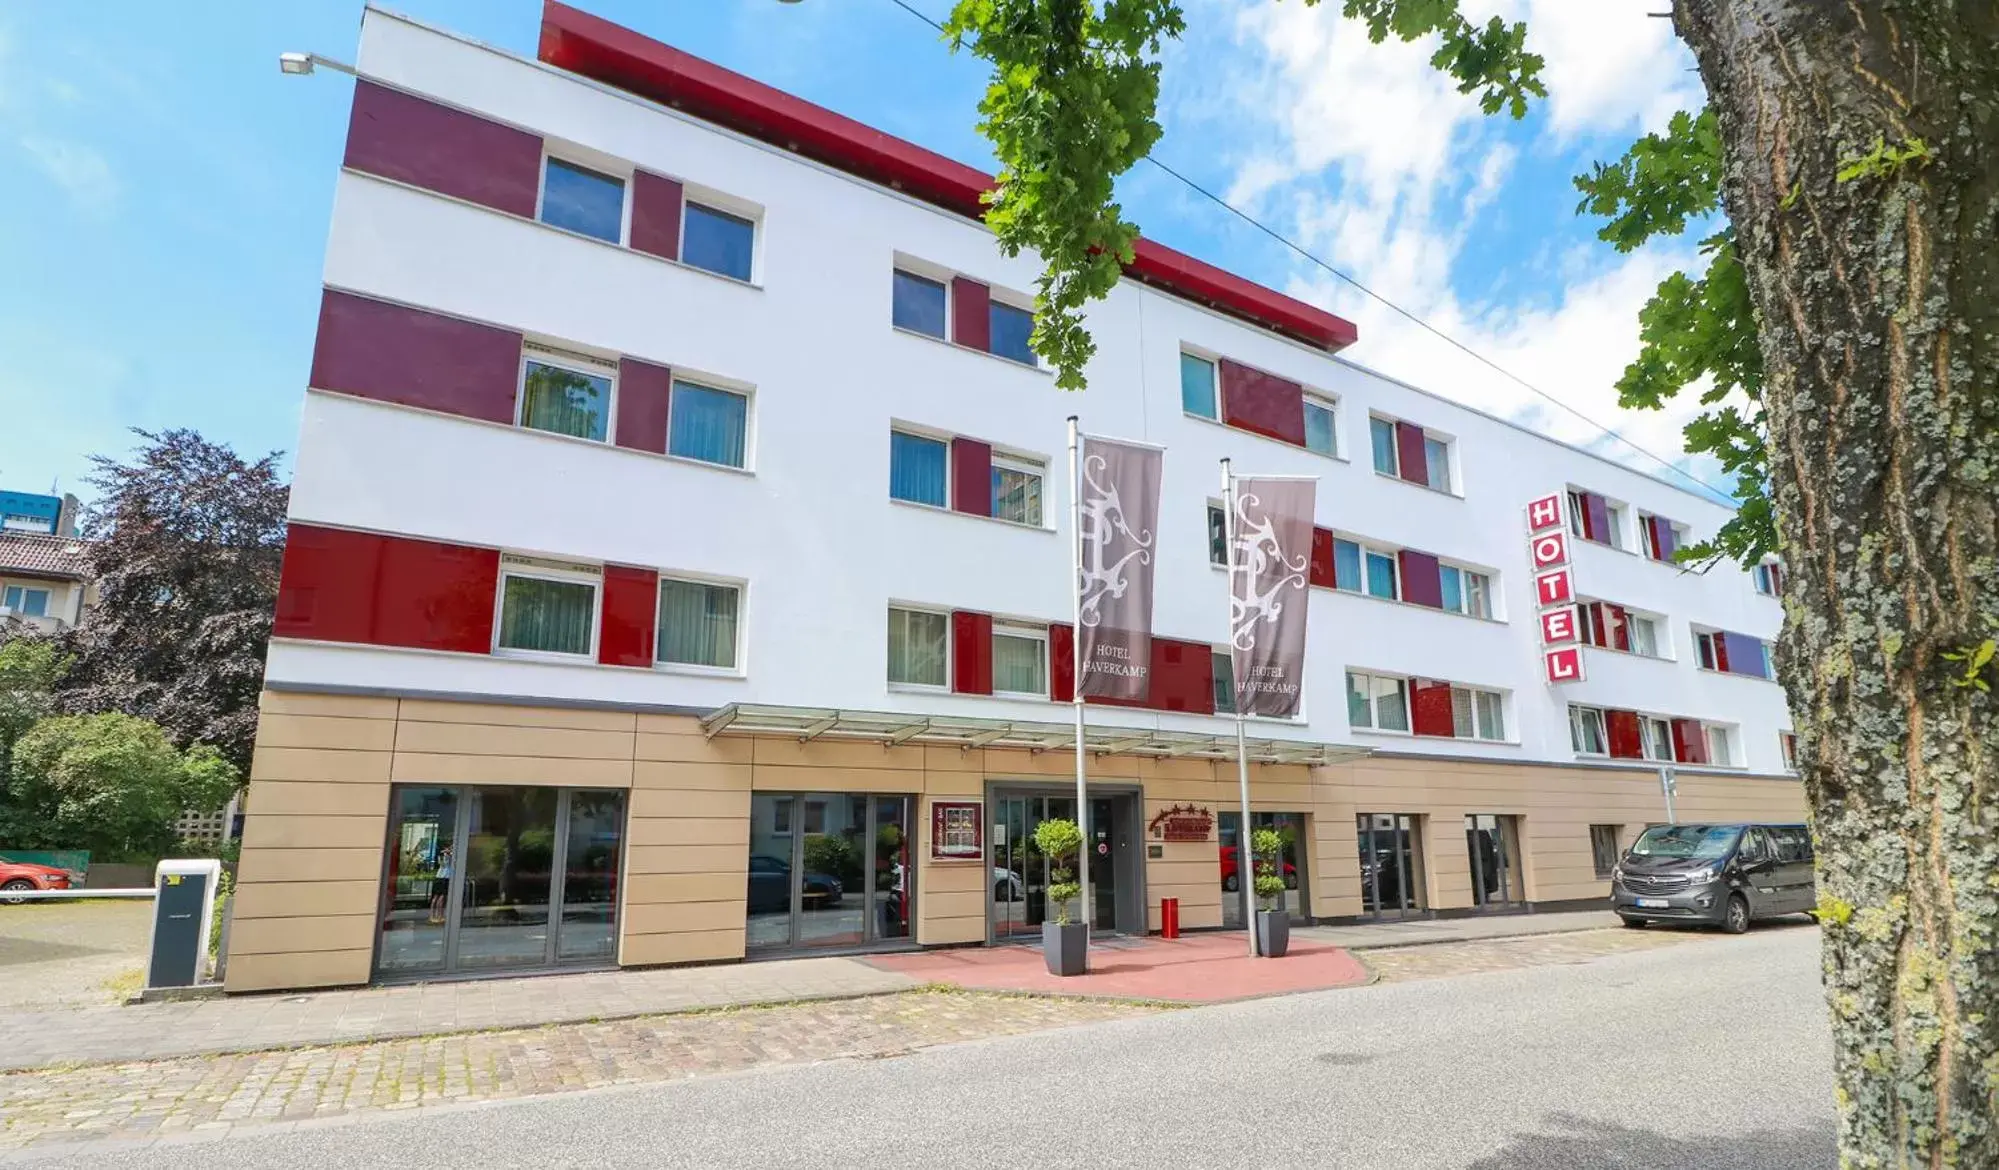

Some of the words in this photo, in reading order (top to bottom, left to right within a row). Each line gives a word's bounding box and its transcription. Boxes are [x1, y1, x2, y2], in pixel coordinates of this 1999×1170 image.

[1533, 499, 1573, 678] HOTEL
[1097, 644, 1131, 660] HOTEL
[1083, 660, 1147, 678] HAVERKAMP
[1251, 665, 1285, 678] HOTEL
[1237, 681, 1298, 695] HAVERKAMP
